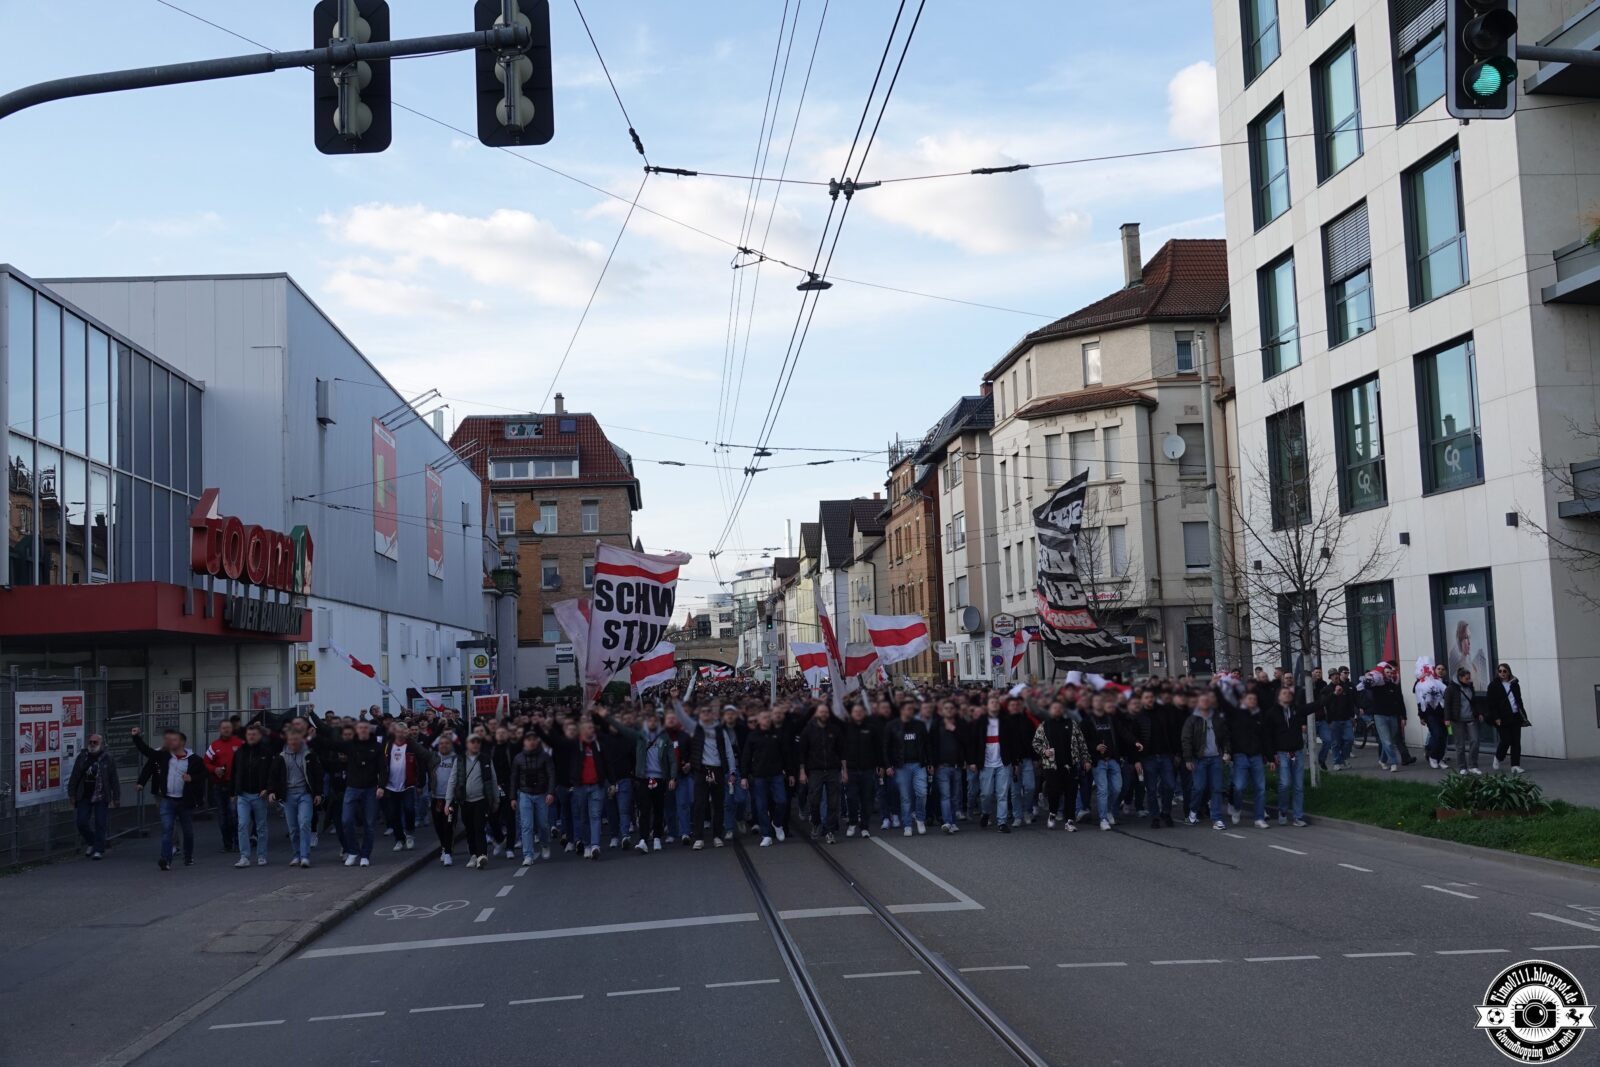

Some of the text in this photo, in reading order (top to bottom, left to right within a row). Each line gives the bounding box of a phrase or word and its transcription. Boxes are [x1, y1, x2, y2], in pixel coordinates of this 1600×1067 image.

[190, 487, 313, 594] toom
[1448, 585, 1467, 597] JOB AG
[239, 597, 304, 635] DER BAUMARKT
